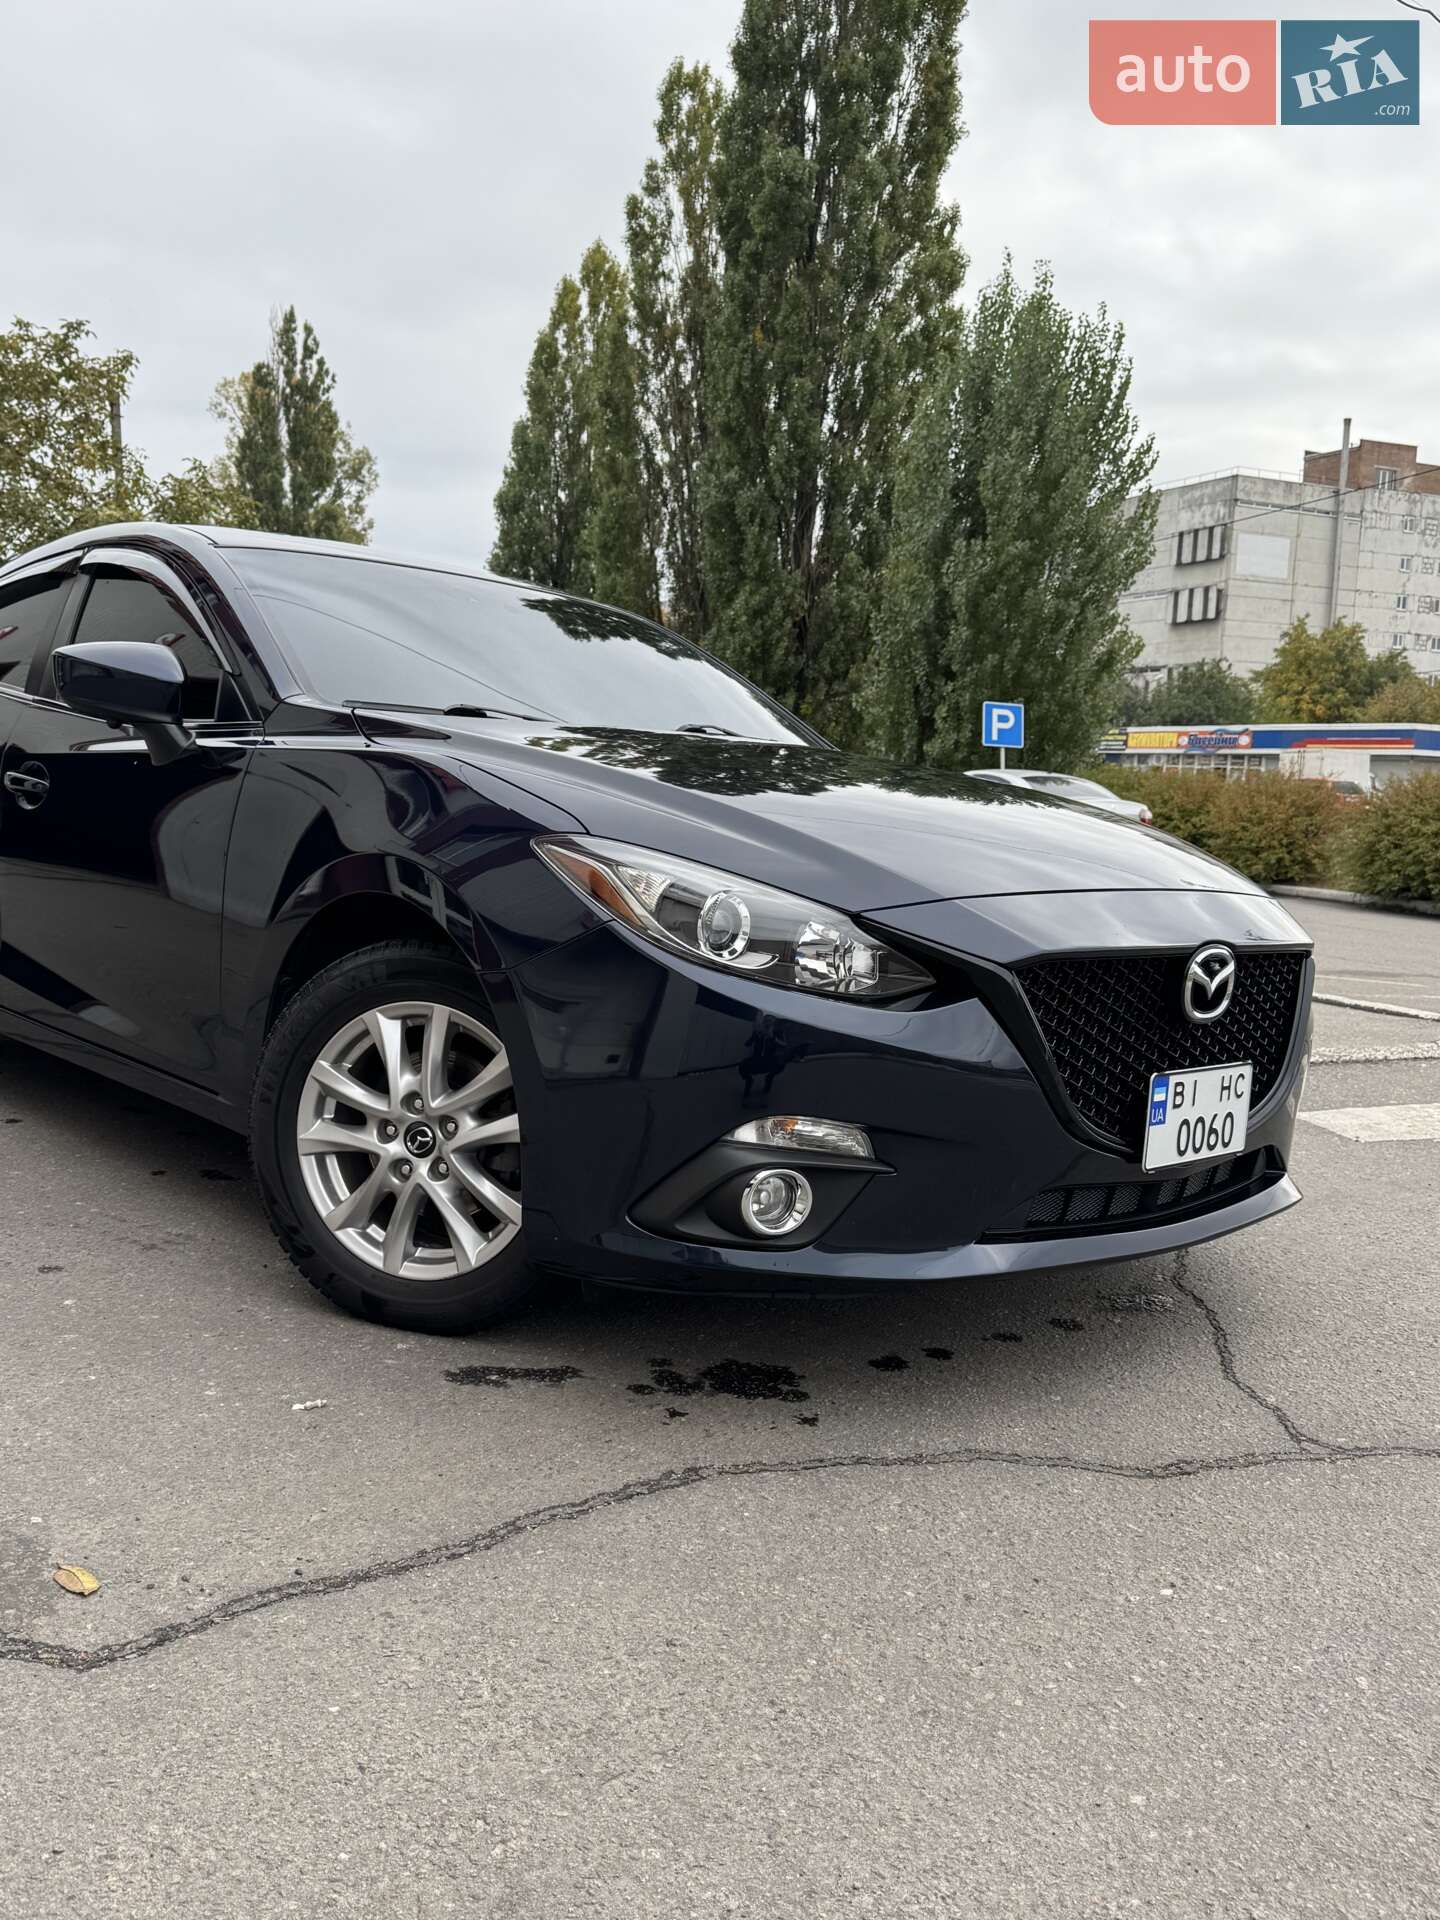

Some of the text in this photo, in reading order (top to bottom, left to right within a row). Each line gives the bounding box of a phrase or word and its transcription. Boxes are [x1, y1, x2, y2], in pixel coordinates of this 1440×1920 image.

[991, 707, 1015, 741] P
[1172, 1072, 1246, 1110] BI HC
[1151, 1108, 1164, 1123] UA
[1176, 1111, 1235, 1157] 0060
